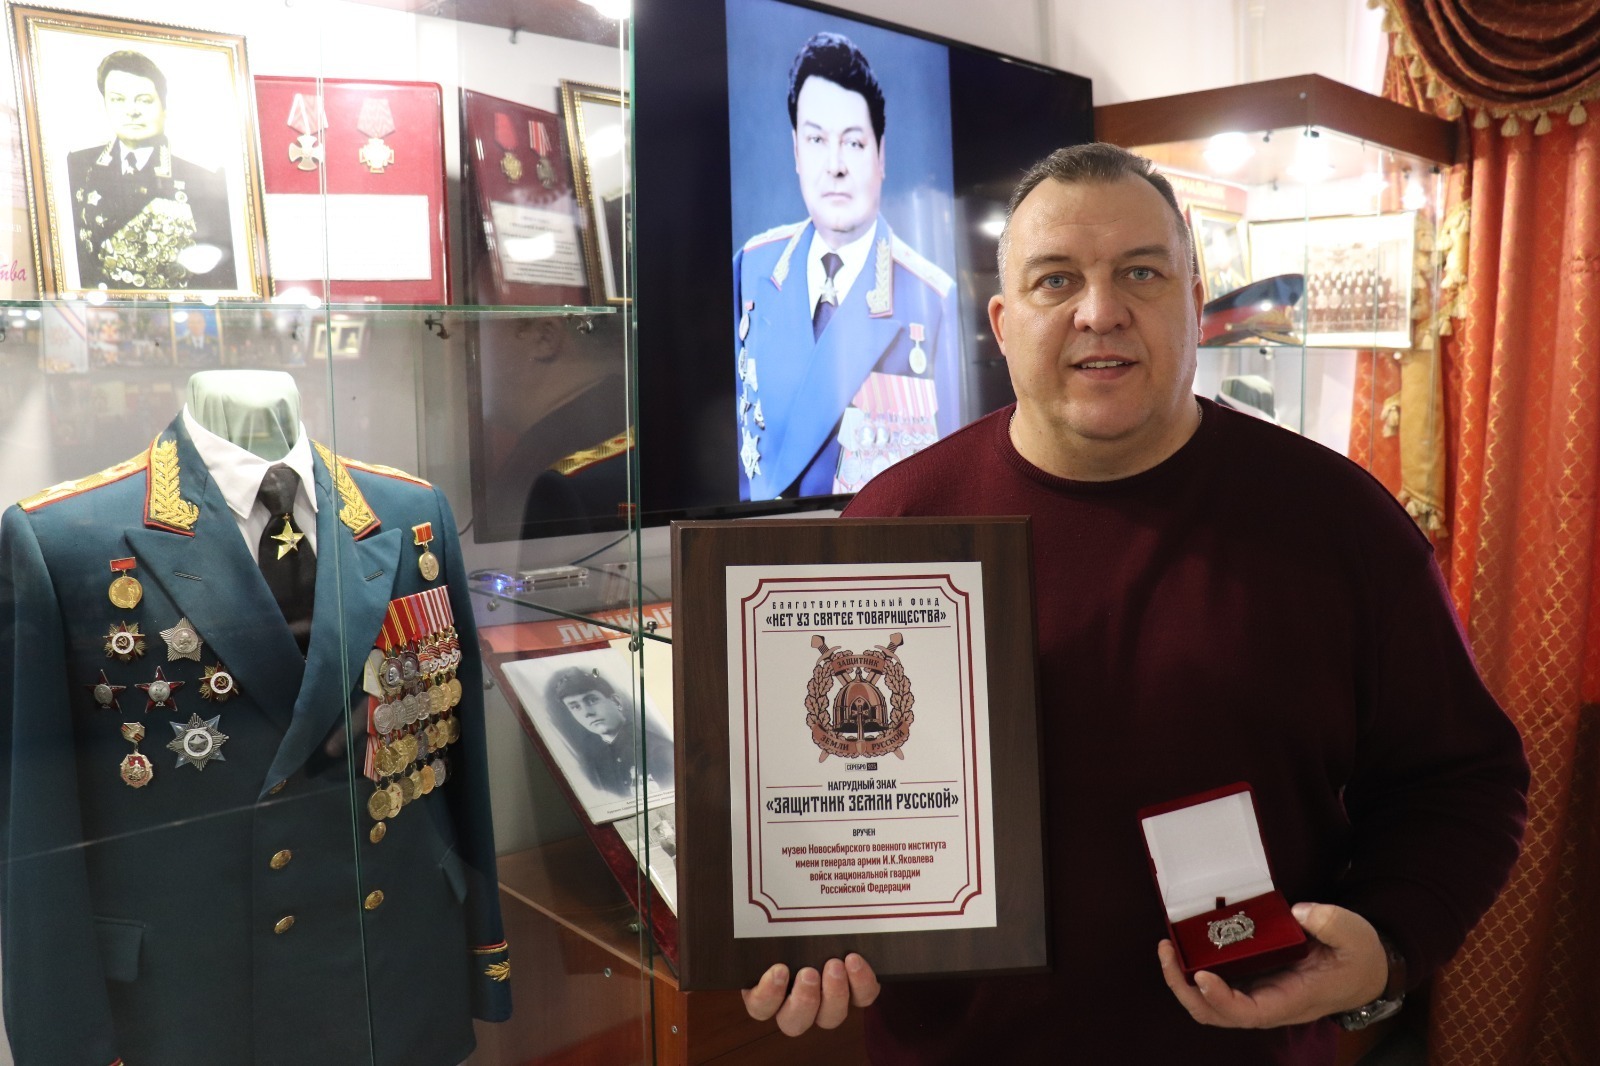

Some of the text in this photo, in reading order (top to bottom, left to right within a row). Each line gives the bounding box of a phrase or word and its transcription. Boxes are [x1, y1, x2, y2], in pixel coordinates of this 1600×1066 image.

[772, 597, 940, 610] БЛАГОТВОРИТЕЛЬНЫЙ ФОНД
[765, 613, 793, 627] «НЕТ
[813, 611, 854, 626] СВЯТЕЕ
[856, 609, 946, 626] ТОВАРИЩЕСТВА»
[836, 657, 880, 668] ЗАЩИТНИК
[820, 728, 905, 751] ЗЕМЛИ РУССКОЙ
[846, 763, 866, 771] СЕРЕБРО
[827, 777, 897, 792] НАГРУДНЫЙ ЗНАК
[766, 787, 958, 816] «ЗАЩИТНИК ЗЕМЛИ РУССКОЙ»
[852, 828, 876, 837] ВРУЧЕН
[781, 840, 946, 857] музею Новосибирского военного института
[795, 854, 934, 869] имени генерала армии И.К.Яковлева
[810, 868, 921, 882] войск национальной гвардии
[820, 881, 911, 895] Российской Федерации
